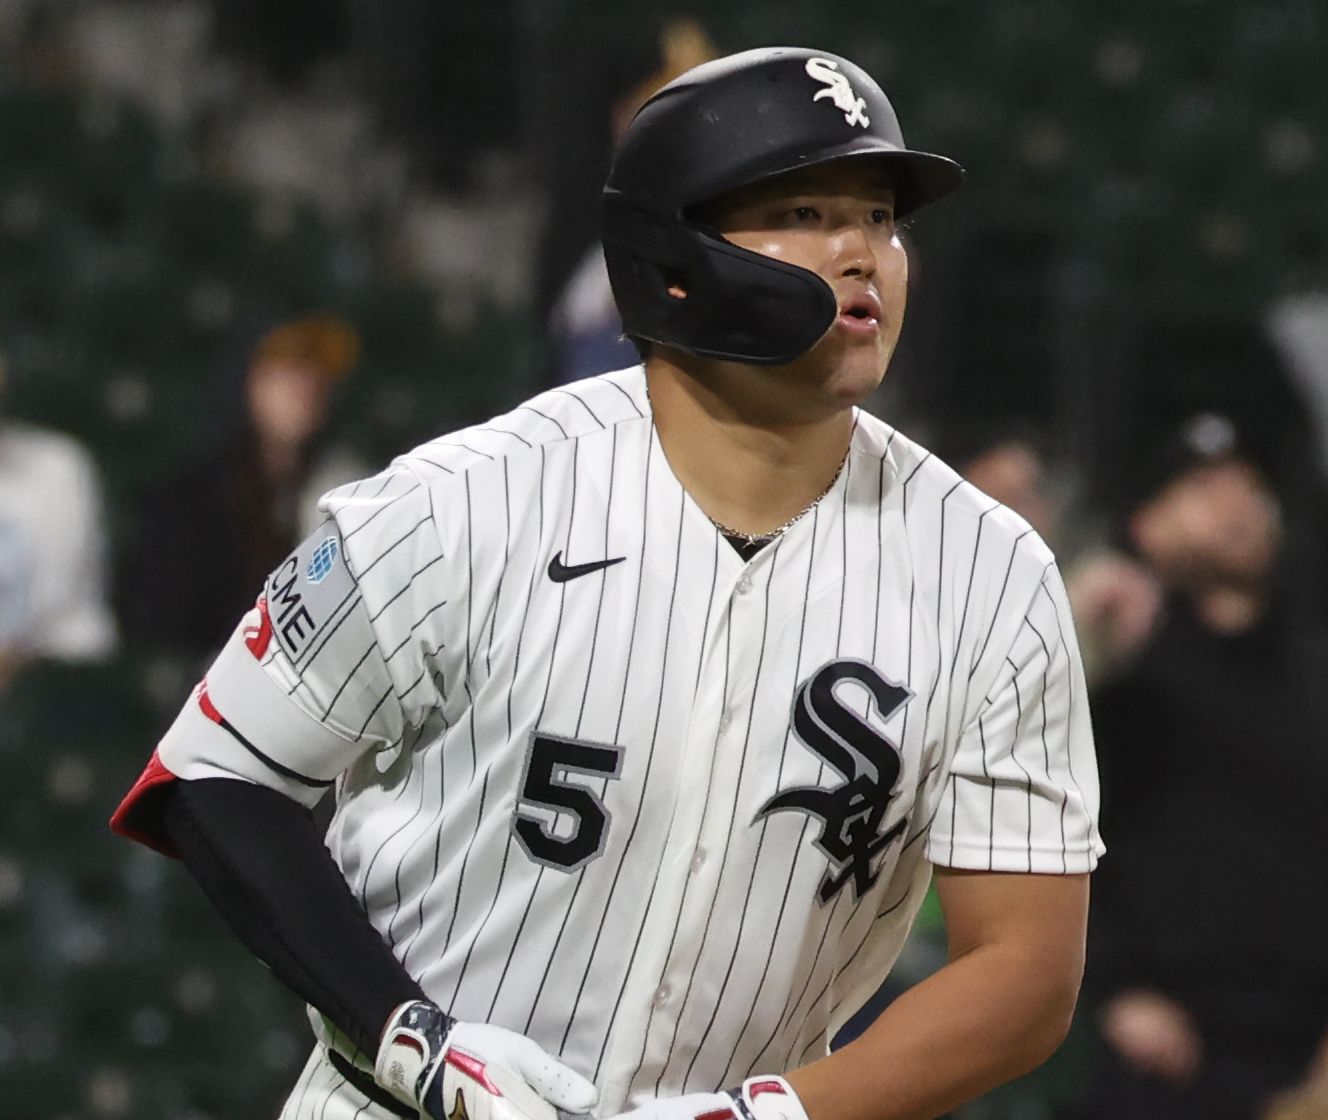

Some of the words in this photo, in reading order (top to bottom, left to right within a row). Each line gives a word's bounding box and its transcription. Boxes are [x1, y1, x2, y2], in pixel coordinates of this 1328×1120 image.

[272, 556, 315, 653] CME
[511, 730, 626, 875] 5
[749, 657, 917, 908] Sox
